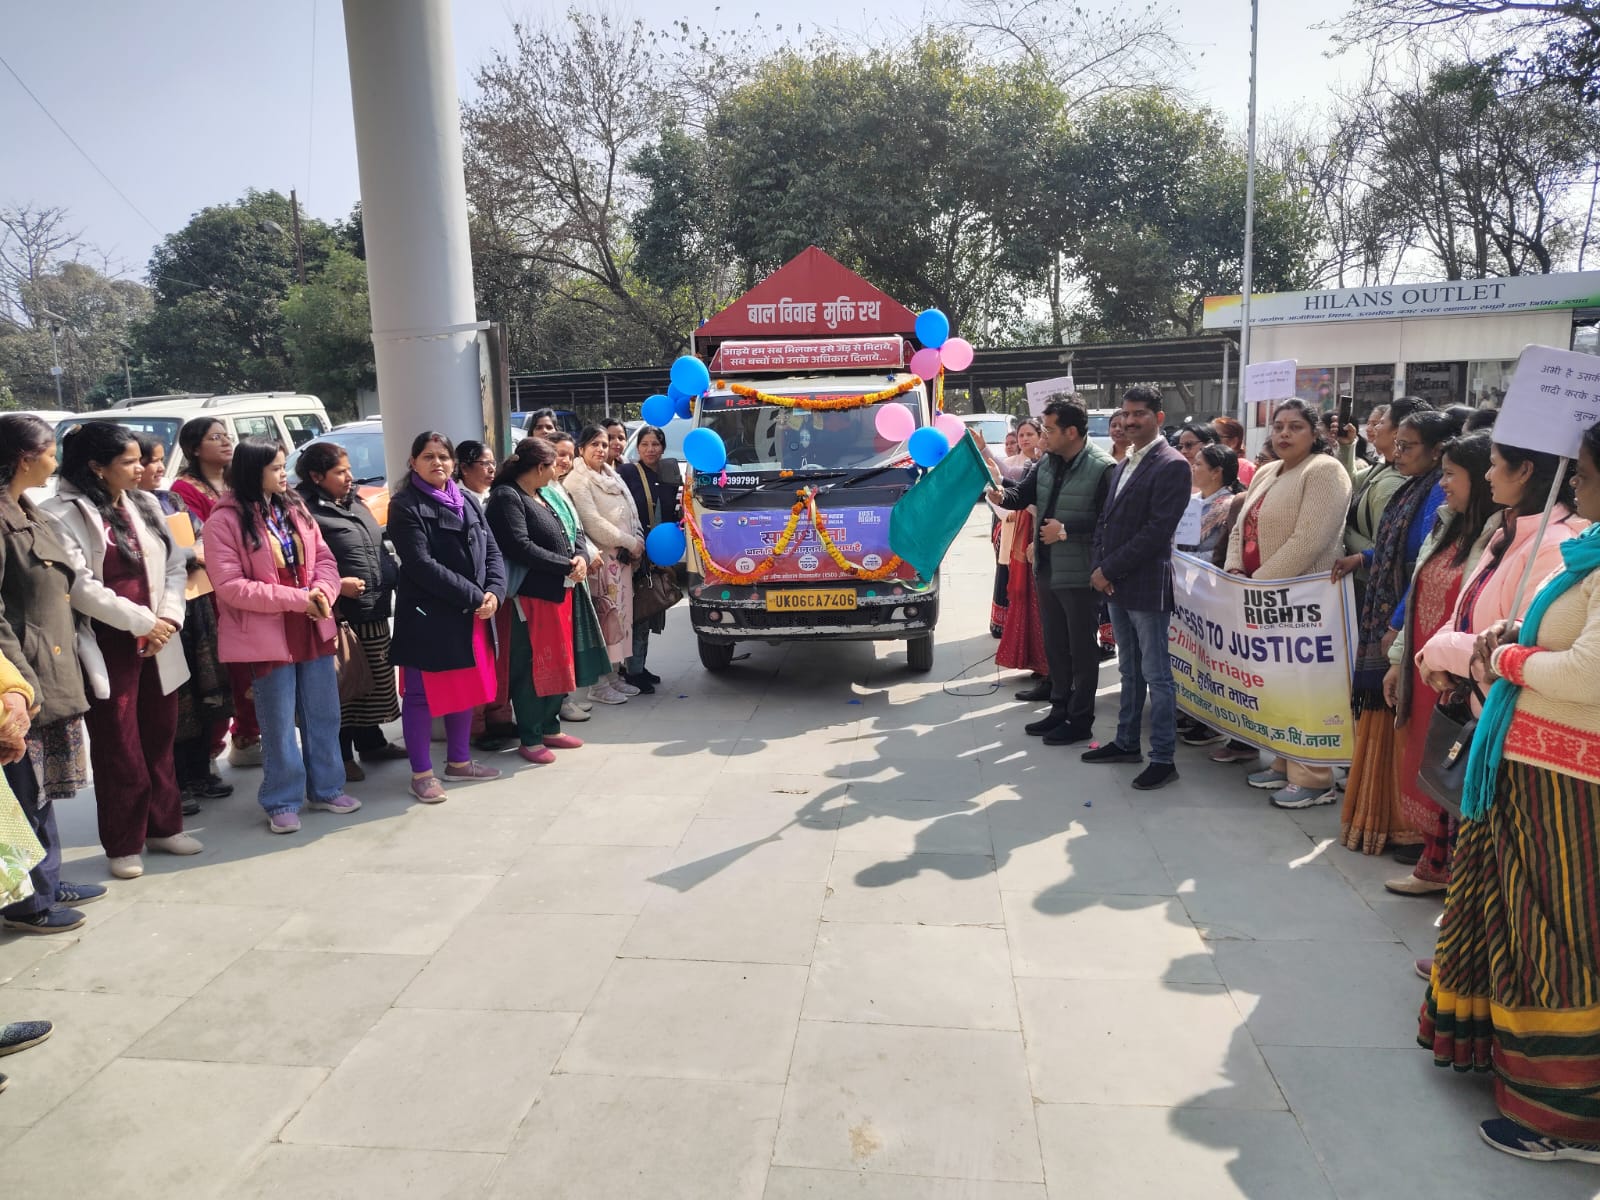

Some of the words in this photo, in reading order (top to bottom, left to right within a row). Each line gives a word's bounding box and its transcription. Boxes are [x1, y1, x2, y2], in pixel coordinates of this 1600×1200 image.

[1305, 291, 1393, 310] HILANS
[1402, 283, 1506, 304] OUTLET
[747, 304, 776, 324] बाल
[778, 297, 817, 323] विवाह
[822, 295, 857, 329] मुक्ति
[857, 301, 881, 321] रथ
[1541, 365, 1562, 375] अभी
[1577, 371, 1600, 383] उसक
[1540, 384, 1561, 395] शादी
[1565, 389, 1589, 400] करके
[712, 475, 760, 486] 83997991
[776, 593, 855, 608] UK06CA7406
[1243, 588, 1290, 607] JUST
[1244, 604, 1322, 625] RIGHTS
[1206, 620, 1223, 650] TO
[1229, 630, 1335, 663] JUSTICE
[1168, 626, 1197, 655] Child
[1199, 644, 1264, 688] Marriage
[1228, 686, 1259, 711] भारत
[1214, 704, 1241, 728] (ISD)
